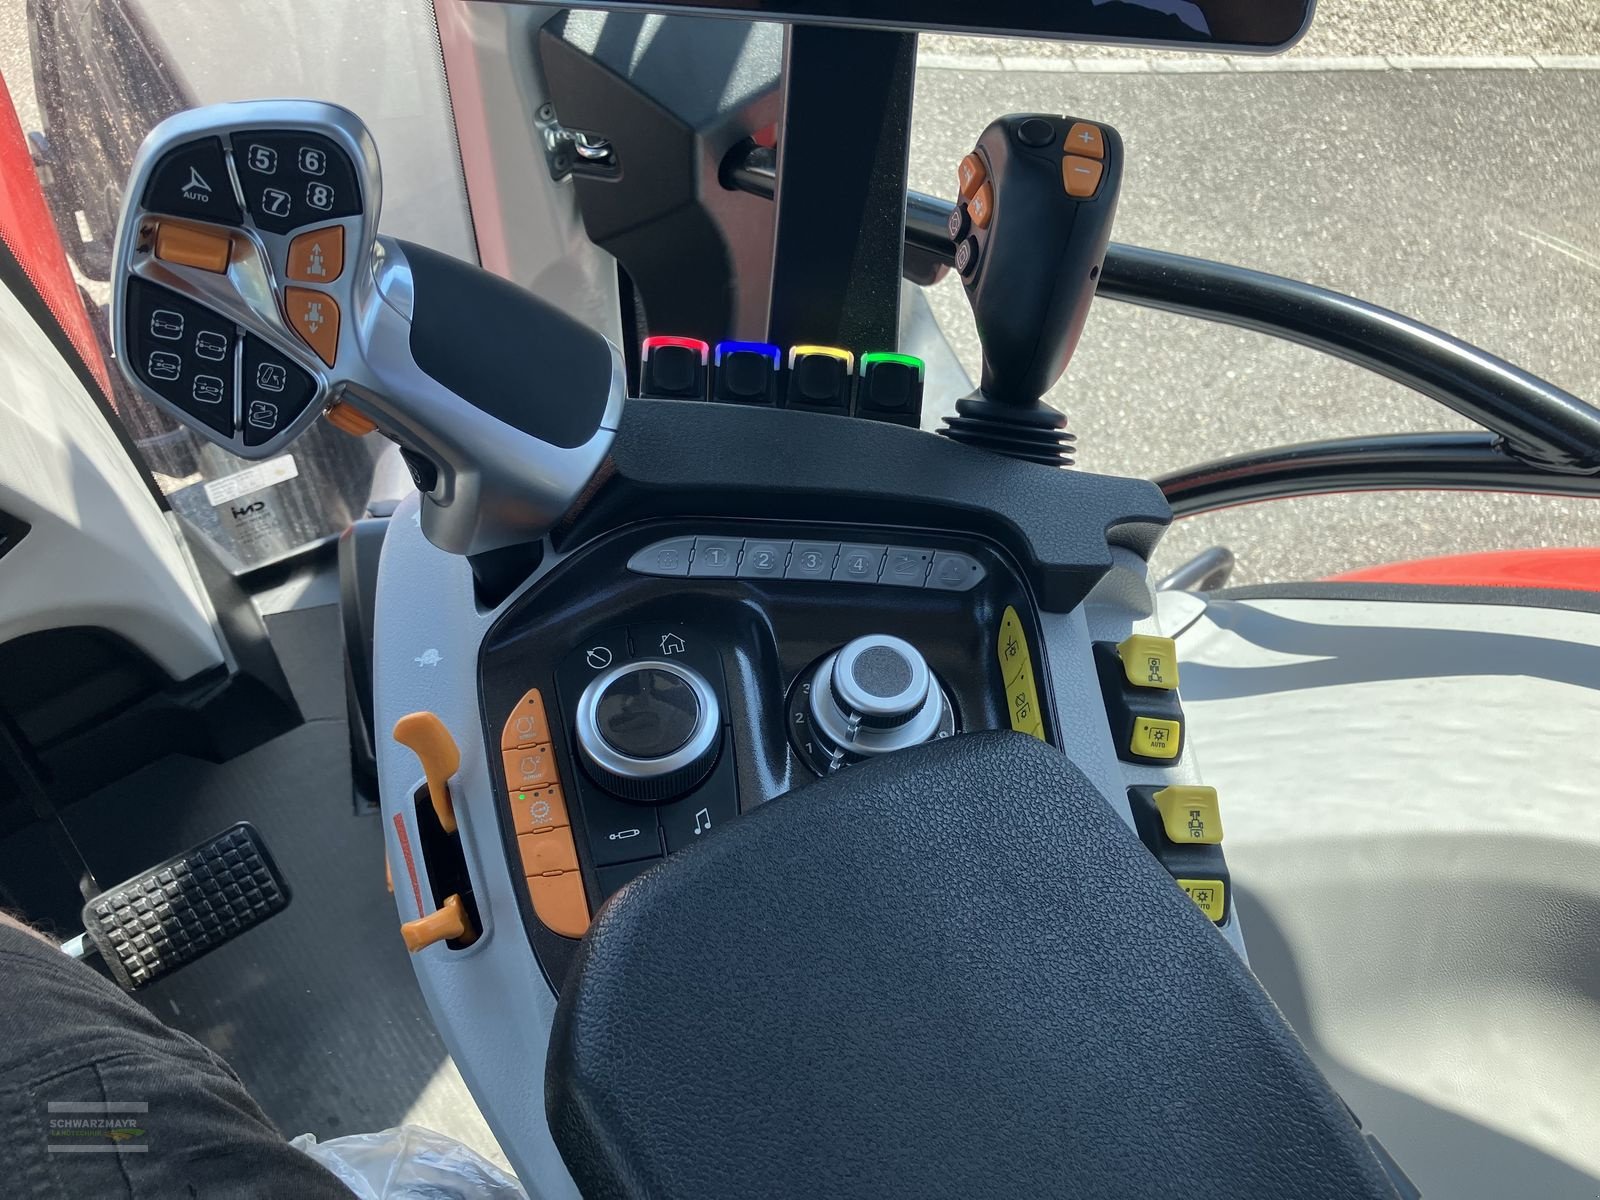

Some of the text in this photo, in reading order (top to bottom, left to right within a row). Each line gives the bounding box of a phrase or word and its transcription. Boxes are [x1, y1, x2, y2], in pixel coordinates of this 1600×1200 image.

[255, 151, 269, 169] 5
[305, 152, 320, 171] 6
[183, 191, 209, 203] AUTO
[271, 192, 286, 211] 7
[313, 186, 327, 205] 8
[758, 553, 769, 567] 2
[806, 553, 817, 568] 3
[853, 557, 864, 571] 4
[802, 683, 810, 695] 3
[795, 712, 805, 724] 2
[805, 742, 813, 754] 1
[1150, 741, 1166, 749] AUTO
